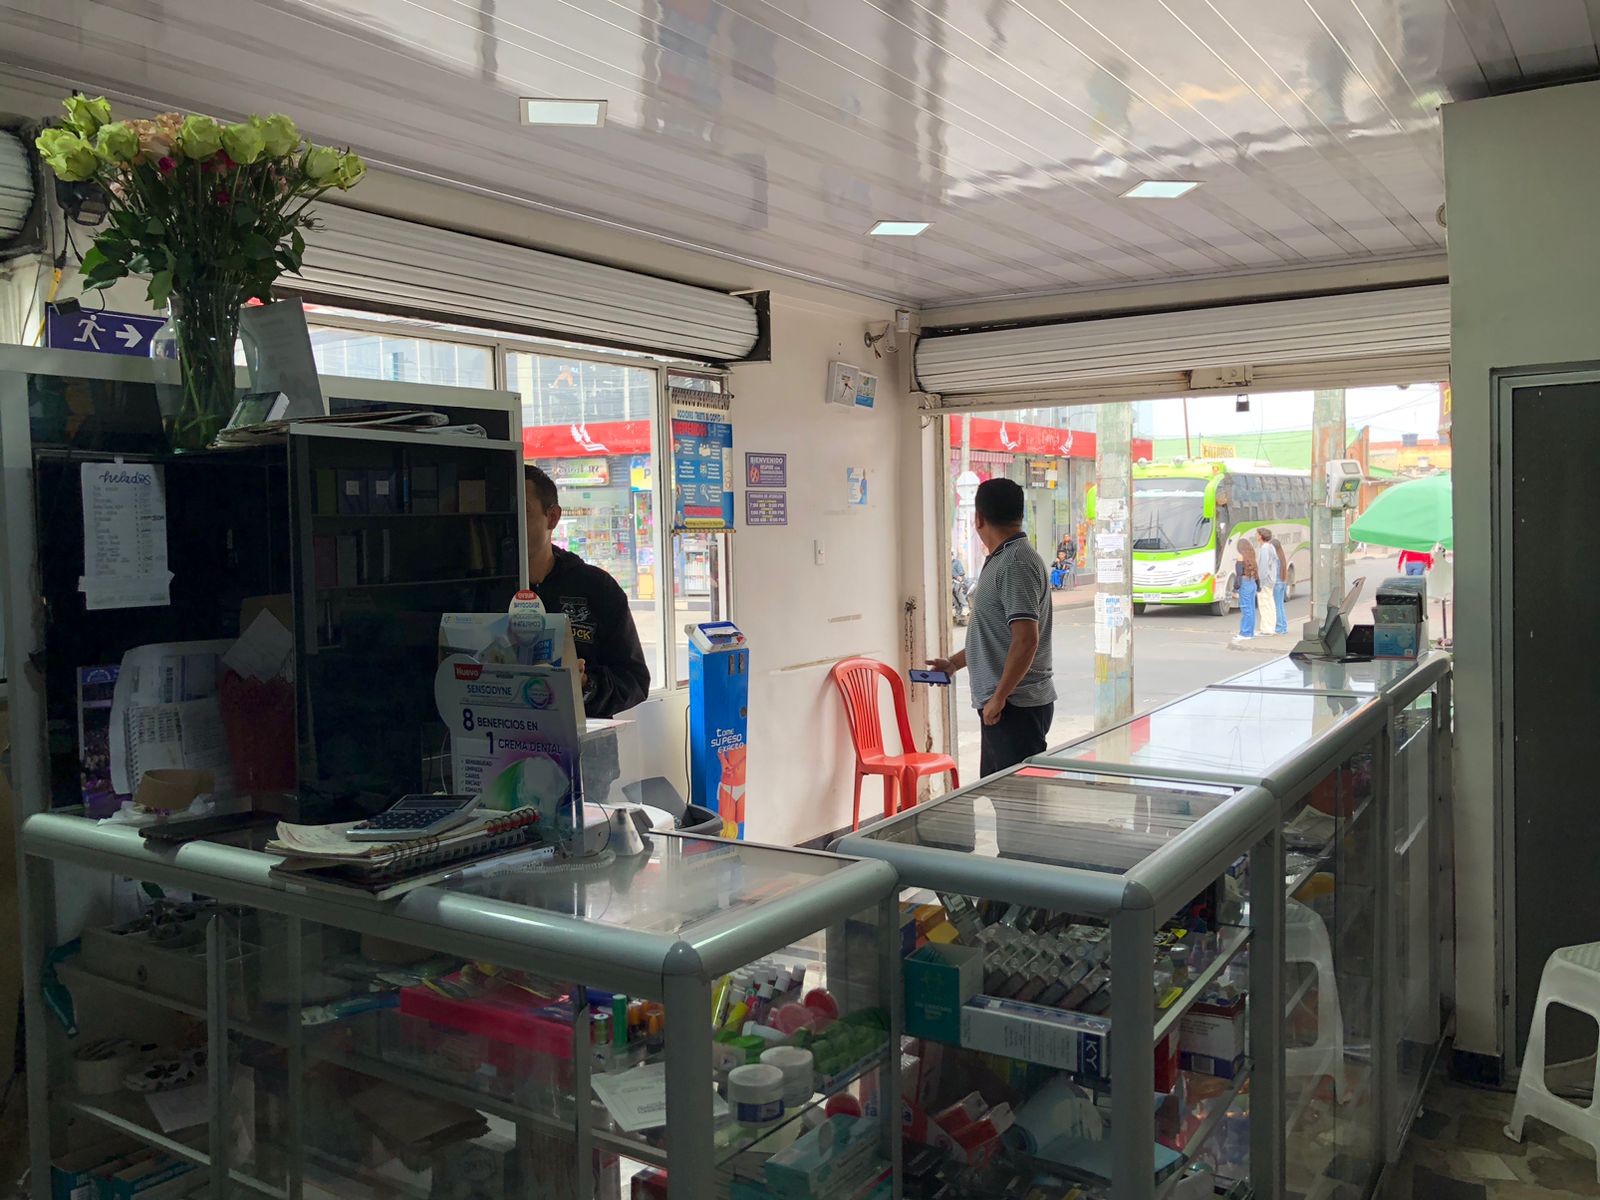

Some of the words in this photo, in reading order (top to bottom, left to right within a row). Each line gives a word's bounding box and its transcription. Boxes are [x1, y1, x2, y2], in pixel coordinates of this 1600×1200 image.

[750, 456, 784, 465] BIENVENIDO
[98, 470, 152, 486] helados
[572, 629, 592, 641] UCK
[455, 666, 480, 678] Nuevo
[466, 683, 513, 697] SENSODYNE
[462, 708, 475, 731] 8
[477, 716, 526, 732] BENEFICIOS
[526, 719, 539, 732] EN
[486, 731, 495, 755] 1
[498, 737, 529, 752] CREMA
[529, 740, 563, 755] DENTAL
[710, 738, 722, 748] SU
[721, 733, 743, 746] PESO
[1085, 1039, 1099, 1071] KY
